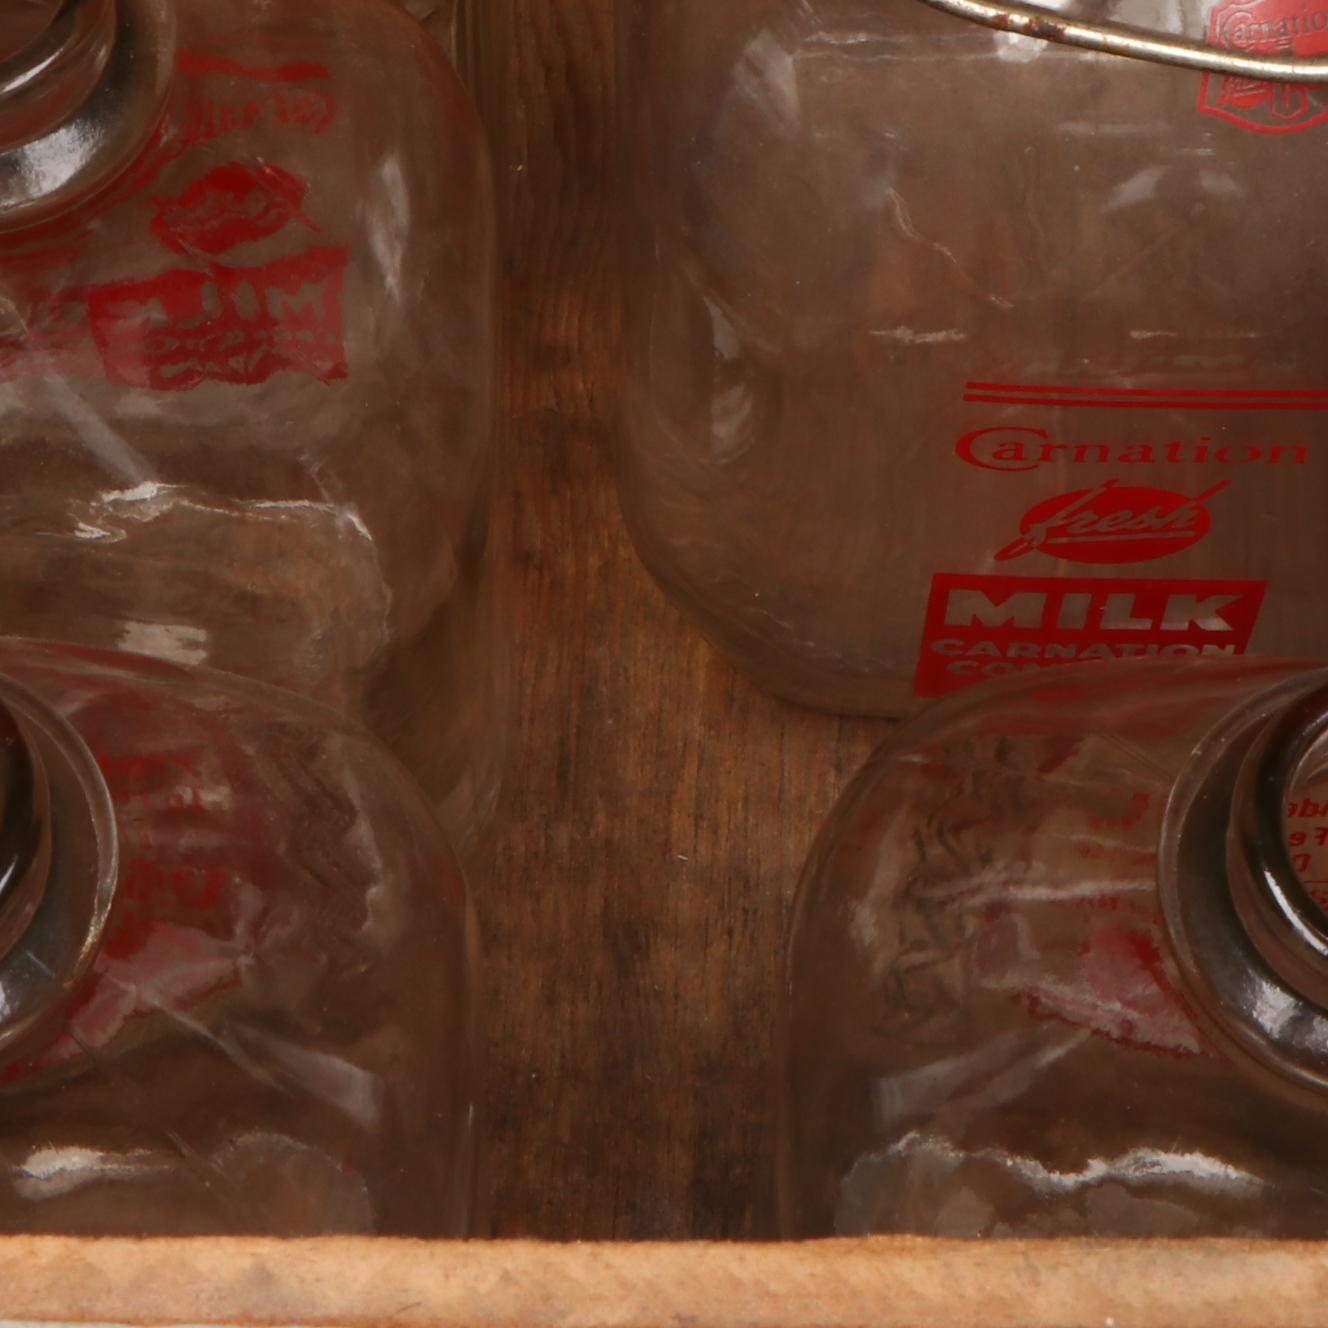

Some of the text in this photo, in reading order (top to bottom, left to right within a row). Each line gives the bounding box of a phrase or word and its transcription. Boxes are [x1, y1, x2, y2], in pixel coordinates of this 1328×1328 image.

[955, 426, 1310, 473] Carnation
[944, 588, 1244, 632] MILK
[931, 637, 1236, 661] CARNATION
